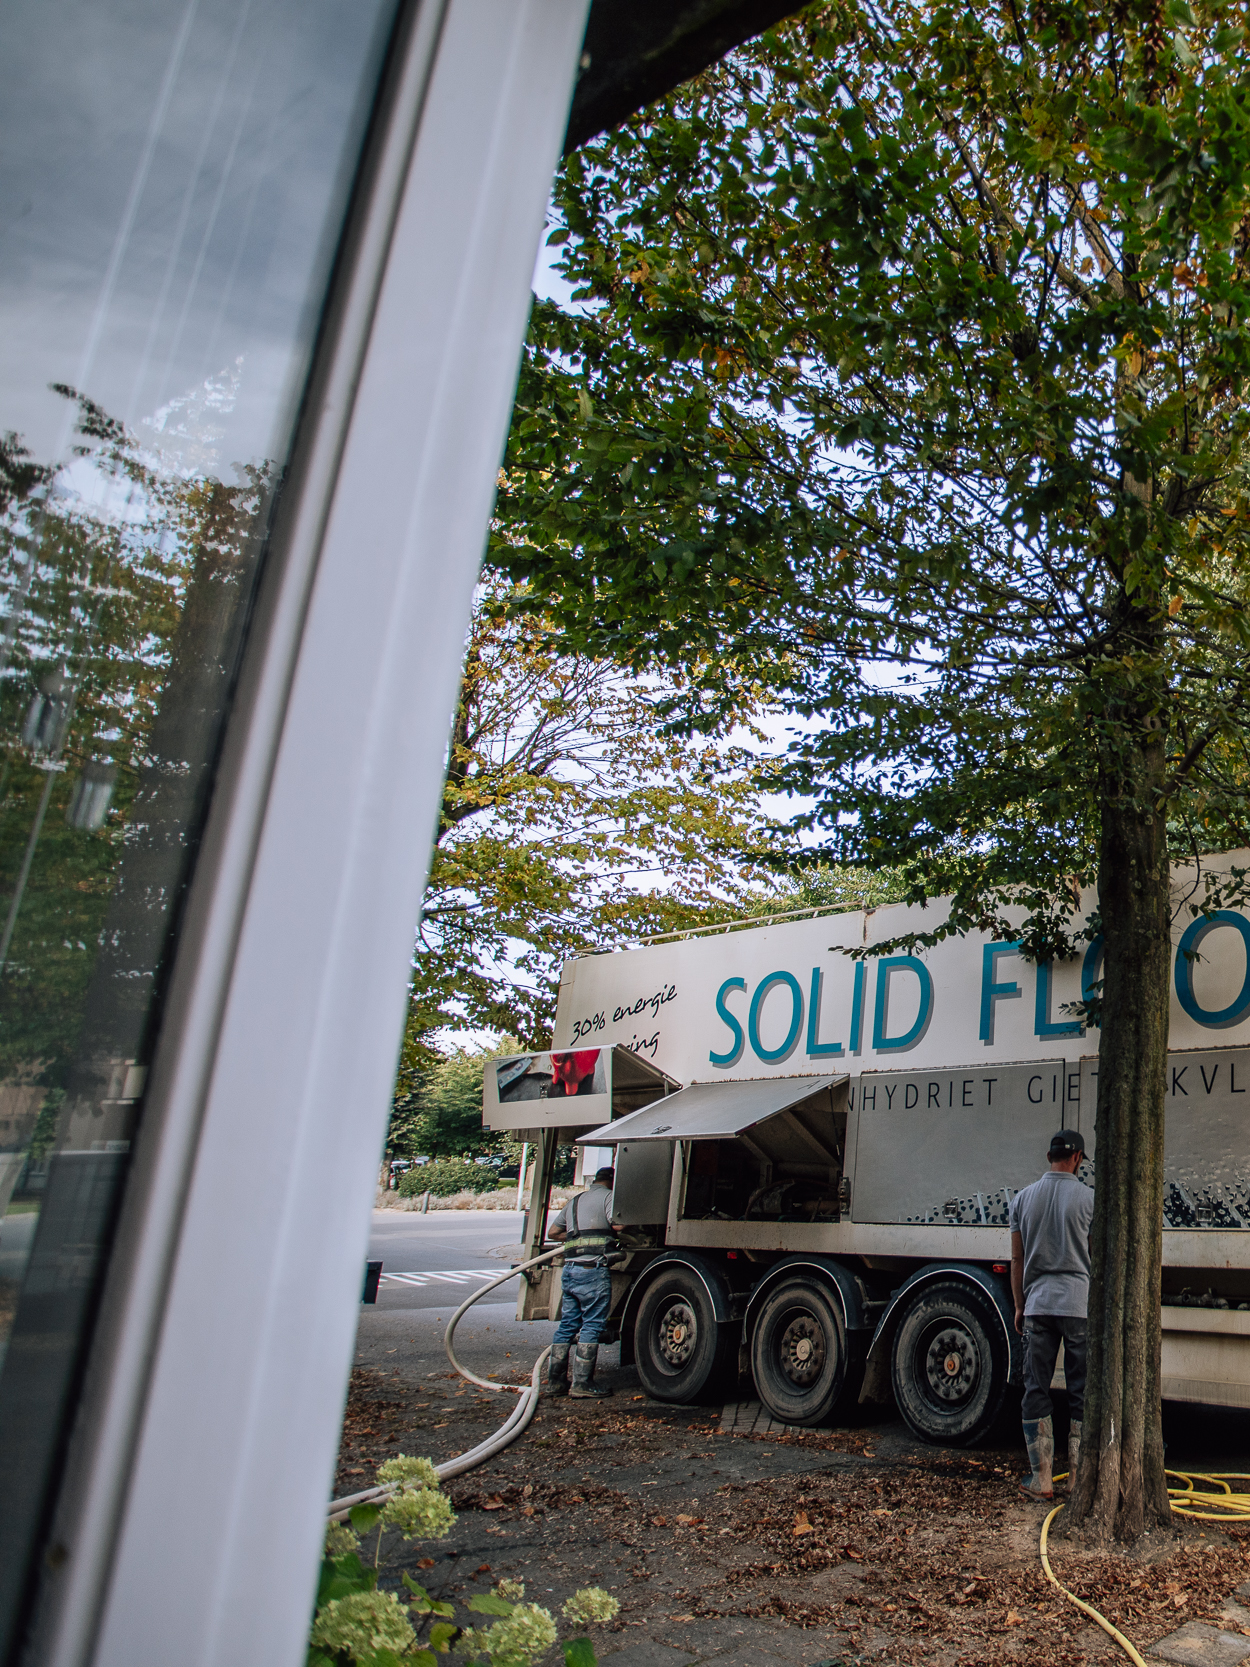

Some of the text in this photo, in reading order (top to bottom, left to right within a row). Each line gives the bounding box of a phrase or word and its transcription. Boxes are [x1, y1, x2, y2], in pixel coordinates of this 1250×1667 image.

[569, 983, 678, 1047] 30% energie
[625, 1030, 661, 1058] ing
[709, 955, 935, 1069] SOLID
